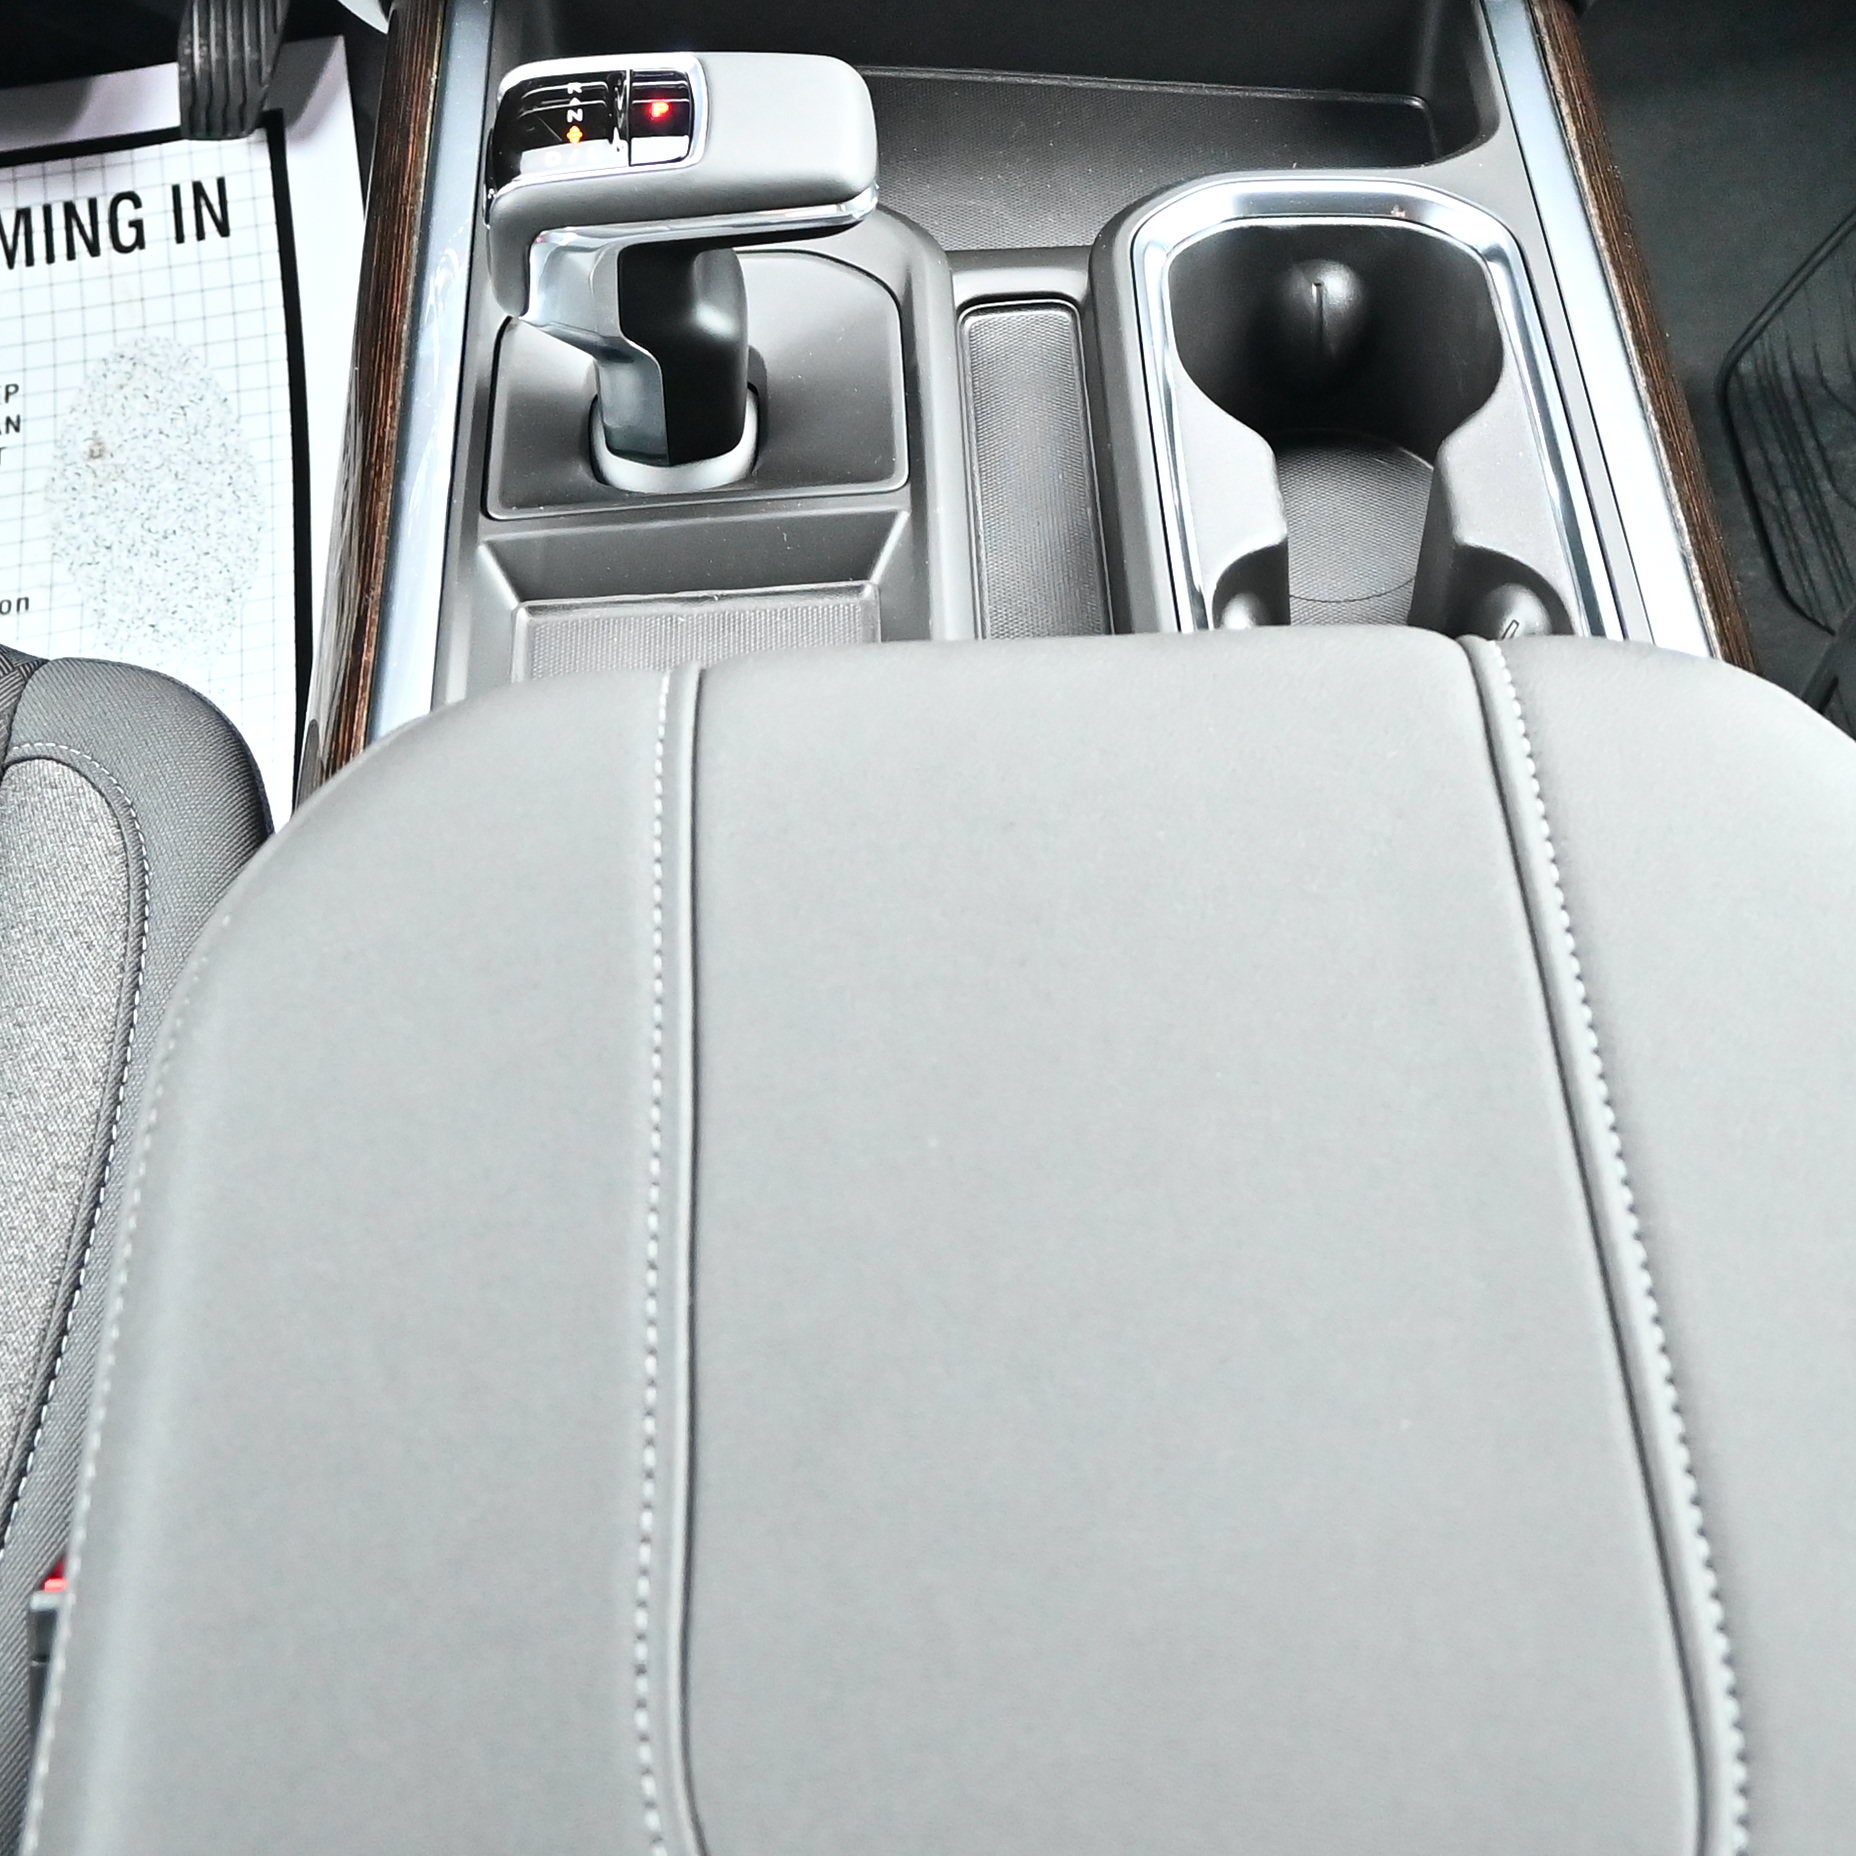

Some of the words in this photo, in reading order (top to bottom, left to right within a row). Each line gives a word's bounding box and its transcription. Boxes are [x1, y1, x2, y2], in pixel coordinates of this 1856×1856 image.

[567, 108, 584, 123] N
[650, 101, 670, 120] P
[172, 176, 233, 247] IN
